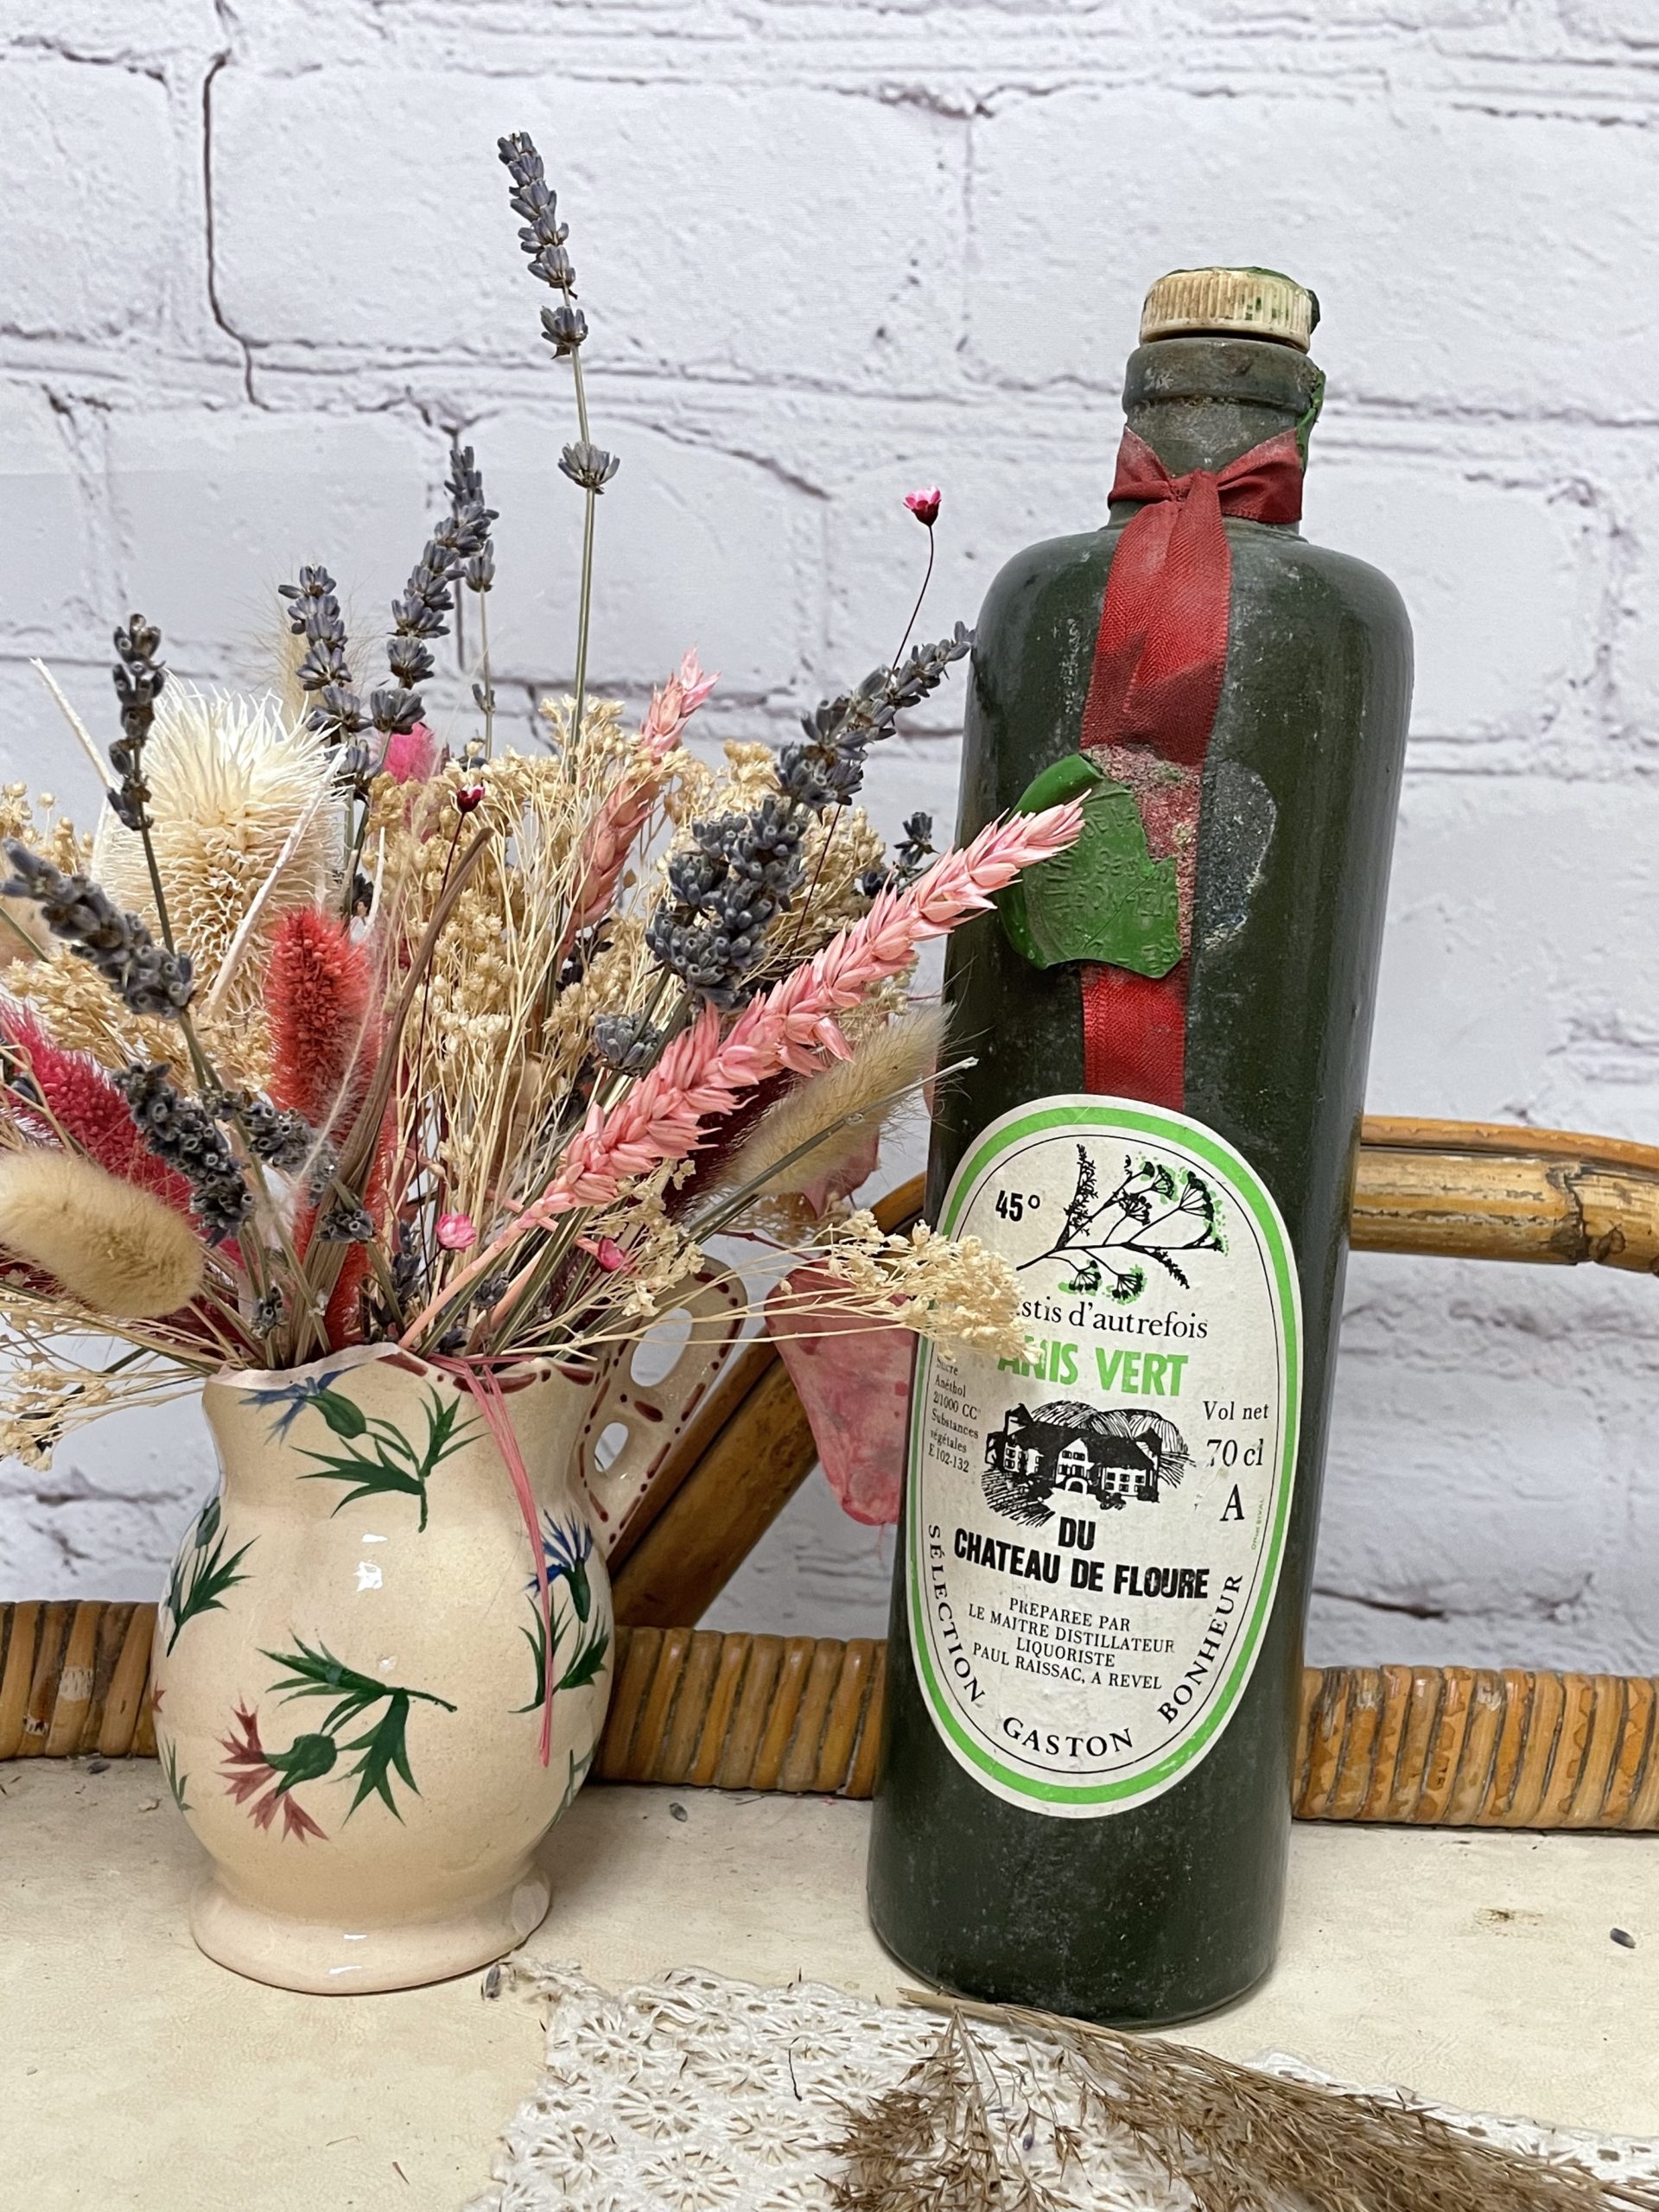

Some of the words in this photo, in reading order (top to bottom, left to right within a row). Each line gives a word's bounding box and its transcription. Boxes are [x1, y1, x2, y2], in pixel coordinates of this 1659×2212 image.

[1015, 1296, 1062, 1323] stis
[1068, 1300, 1209, 1338] d'autrefois
[1095, 1347, 1189, 1396] VERT
[931, 1408, 979, 1439] Substances
[1202, 1401, 1235, 1421] Vol
[1242, 1403, 1269, 1420] net
[930, 1428, 967, 1453] végétales
[1206, 1439, 1238, 1467] 70
[1243, 1438, 1264, 1466] cl
[1219, 1483, 1245, 1522] A
[1058, 1516, 1096, 1551] DU
[953, 1528, 1062, 1585] CHATEAU
[1070, 1558, 1105, 1592] DE
[1113, 1563, 1211, 1599] FLOURE
[968, 1603, 985, 1620] LE
[989, 1610, 1049, 1638] MAITRE
[1055, 1626, 1175, 1653] DISTILLATEUR
[1009, 1597, 1092, 1627] PREPAREE
[1098, 1614, 1131, 1632] PAR
[928, 1524, 986, 1702] SÉLECTION
[1002, 1716, 1134, 1758] GASTON
[1156, 1573, 1243, 1725] BONHEUR
[1015, 1637, 1116, 1668] LIQUORISTE
[972, 1641, 1010, 1666] PAUL
[1014, 1655, 1086, 1684] RAISSAC,
[1090, 1672, 1102, 1685] A
[1109, 1673, 1163, 1690] REVEL
